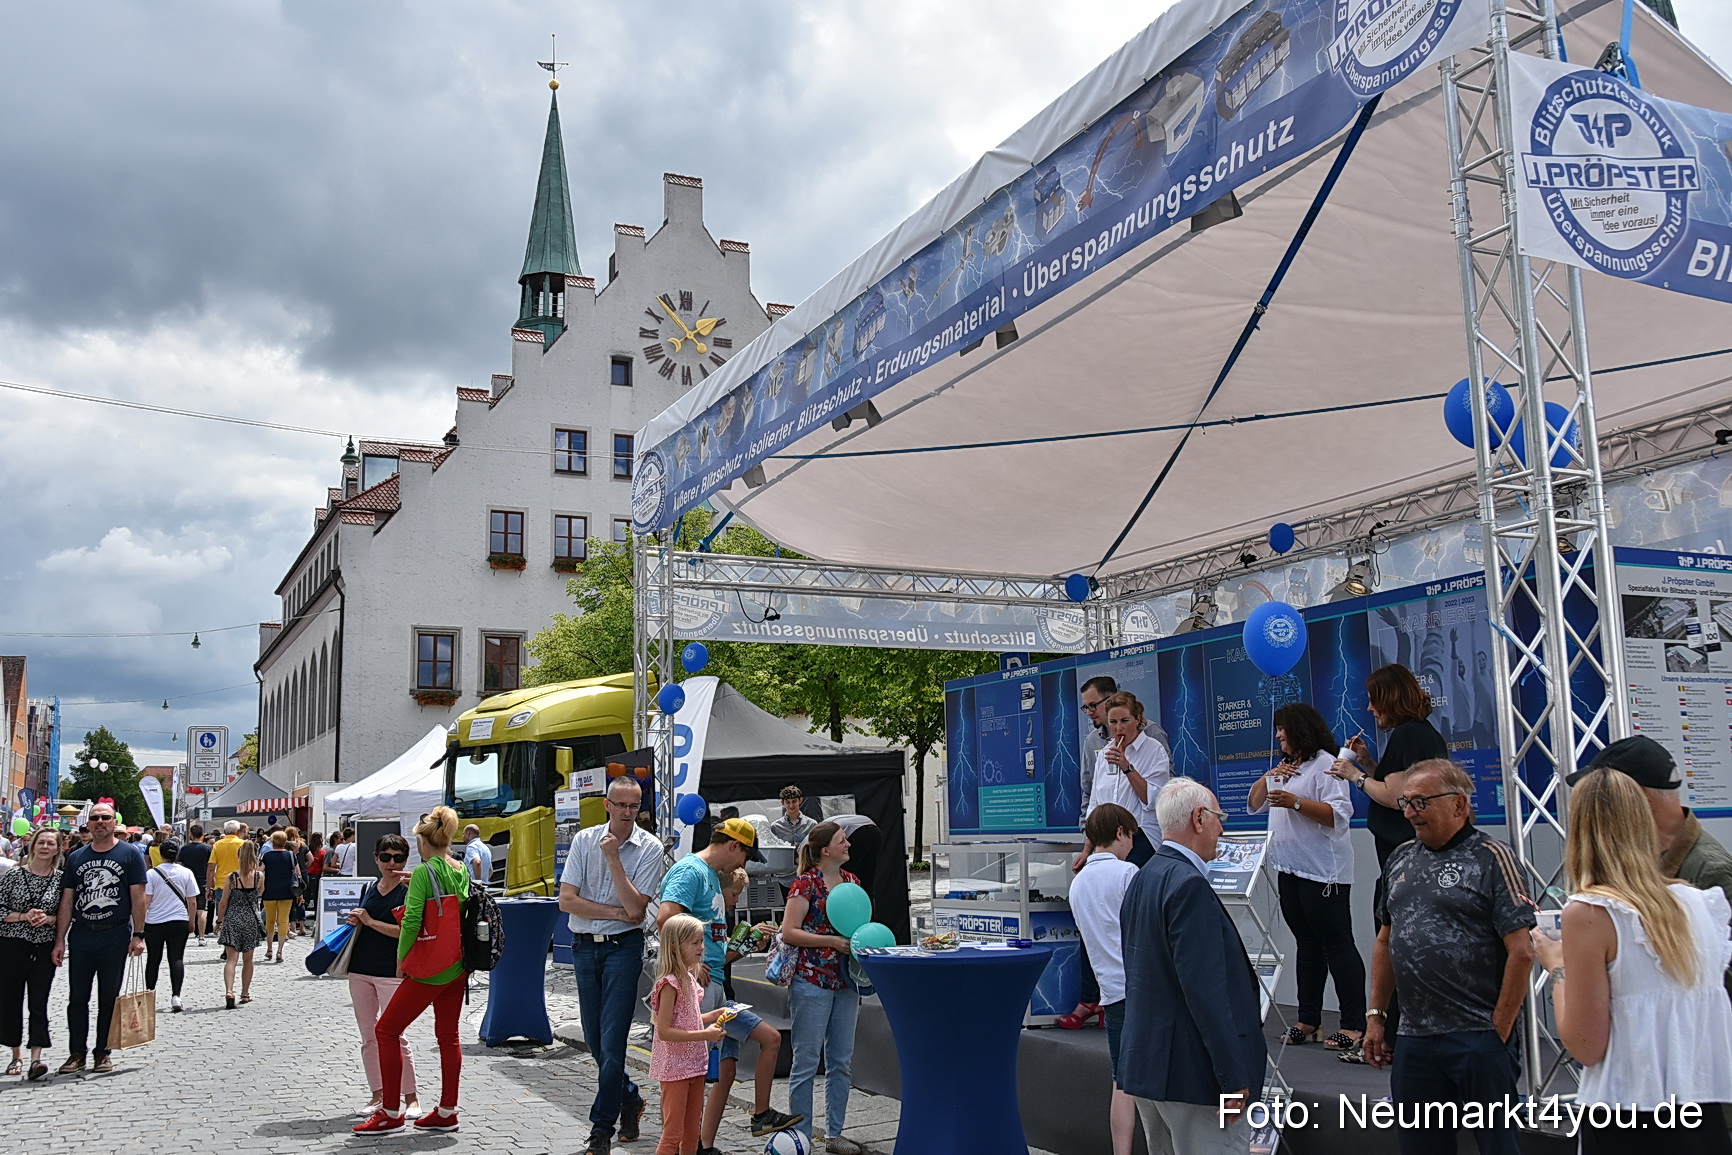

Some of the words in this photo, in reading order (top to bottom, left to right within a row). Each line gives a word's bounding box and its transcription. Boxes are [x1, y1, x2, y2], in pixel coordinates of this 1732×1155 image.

[1366, 1, 1408, 41] Sicherheit
[1371, 21, 1398, 50] immer
[1399, 3, 1416, 24] eine
[1383, 30, 1403, 49] Idee
[1535, 76, 1674, 152] Blitzschutztechnik
[1528, 157, 1700, 190] J.PRÖPSTER
[1570, 196, 1584, 209] Mit
[1584, 192, 1631, 208] Sicherheit
[1590, 208, 1614, 220] immer
[1617, 204, 1639, 217] eine
[1602, 218, 1621, 231] Idee
[1623, 215, 1657, 229] voraus!
[1546, 192, 1683, 273] Überspannungsschutz
[701, 453, 743, 494] Blitzschutz
[749, 419, 795, 460] Isolierter
[797, 376, 862, 432] Blitzschutz
[875, 294, 1005, 385] Erdungsmaterial
[1023, 115, 1296, 298] Überspannungsschutz
[1443, 575, 1487, 592] J.PRÖPS
[1662, 576, 1695, 586] J.Pröpster
[1695, 578, 1716, 587] GmbH
[1445, 599, 1458, 607] 2022
[1400, 604, 1477, 633] KARRIERE
[1217, 700, 1246, 712] STARKER
[1246, 699, 1252, 708] &
[1217, 710, 1249, 722] SICHERER
[1219, 719, 1262, 731] ARBEITGEBER
[1234, 748, 1280, 760] STELLENANGEBOTE
[75, 859, 102, 876] CUSTOM
[103, 859, 125, 876] BIKERS
[75, 887, 120, 911] Snakes
[1003, 925, 1018, 934] GMBH
